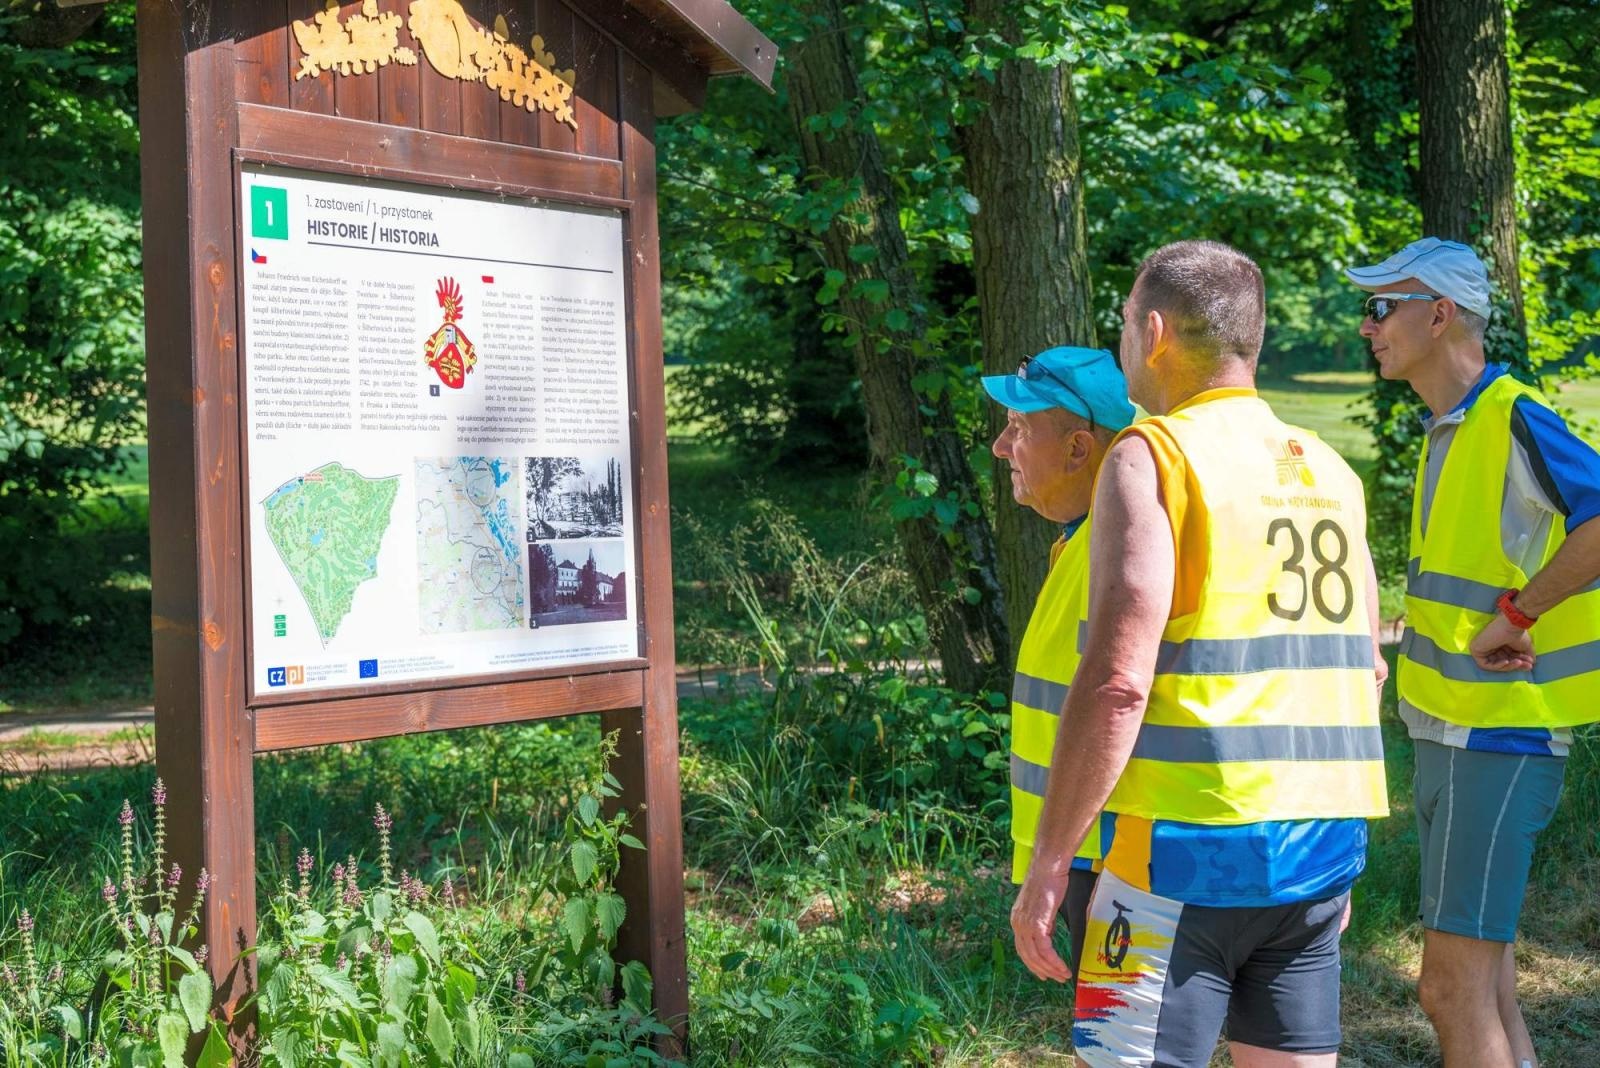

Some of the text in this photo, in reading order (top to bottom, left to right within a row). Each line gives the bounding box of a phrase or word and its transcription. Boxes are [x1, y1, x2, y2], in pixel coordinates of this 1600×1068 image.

[265, 200, 273, 226] 1
[306, 195, 312, 207] 1.
[315, 197, 364, 213] zastavení
[373, 202, 379, 215] 1.
[381, 205, 433, 221] przystanek
[307, 219, 440, 248] HISTORIE / HISTORIA
[1267, 518, 1354, 624] 38
